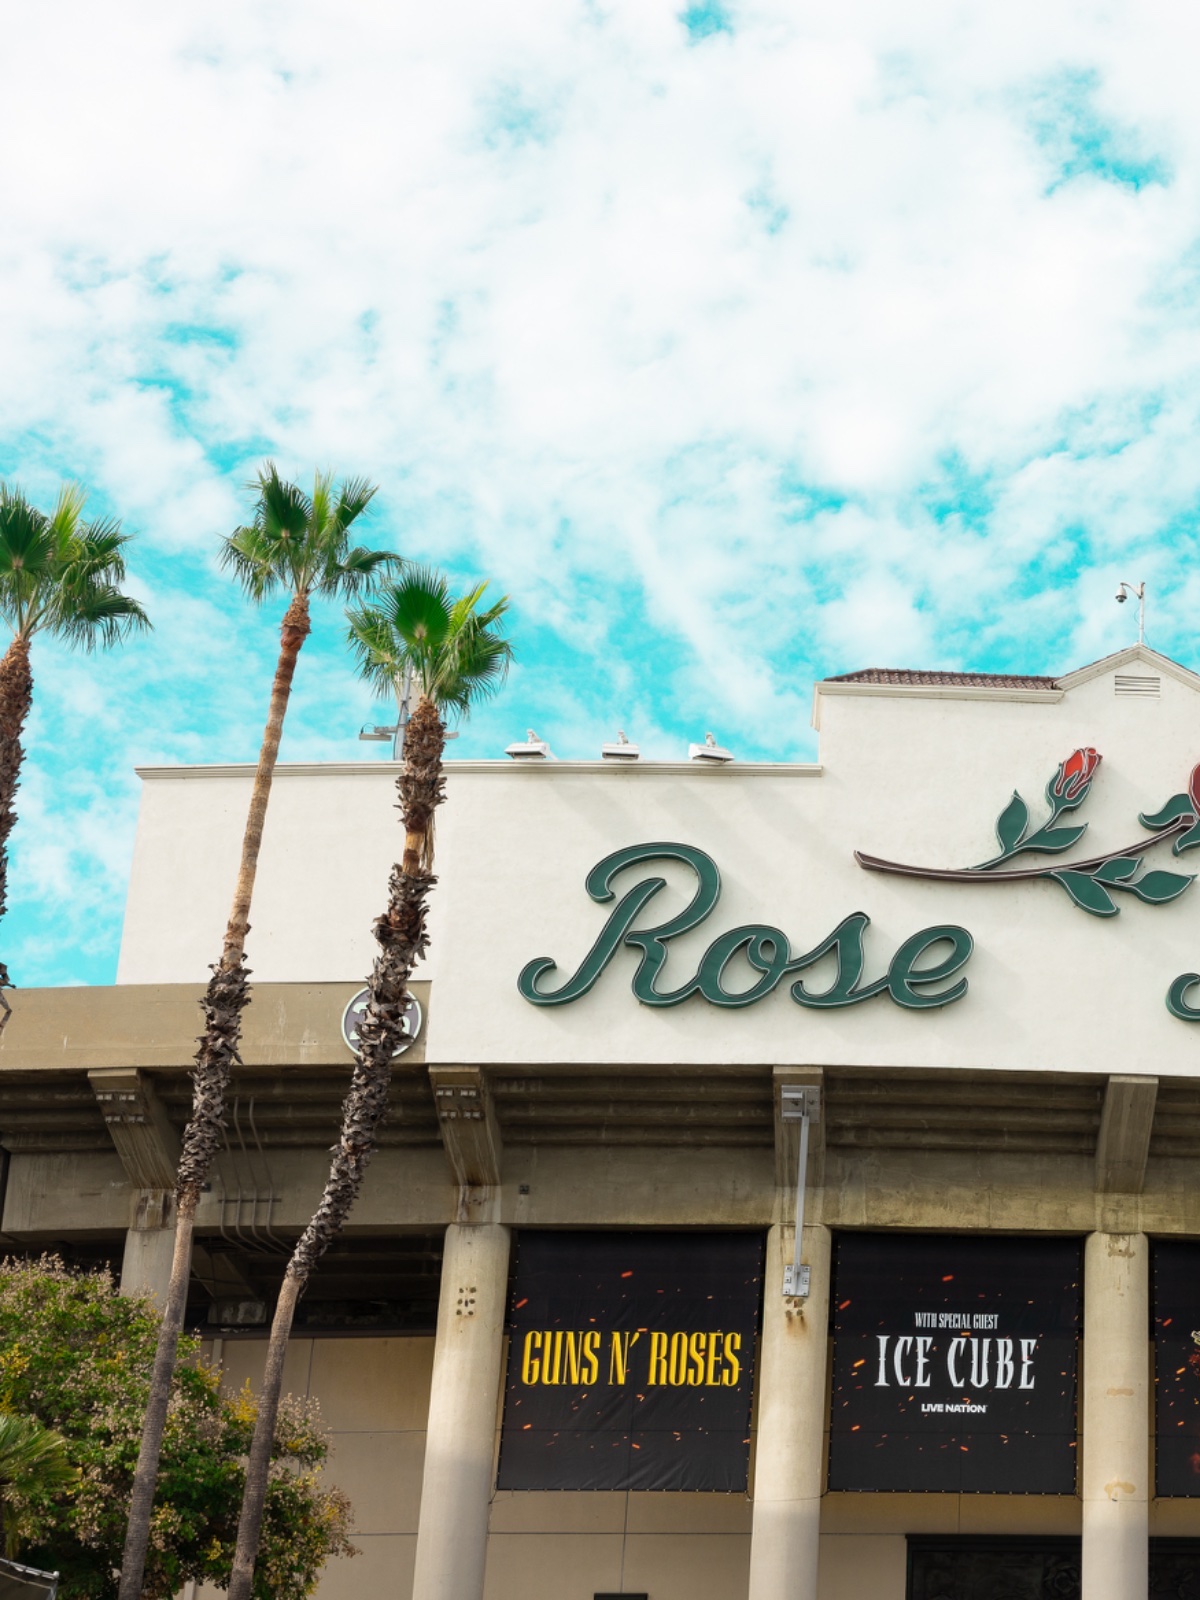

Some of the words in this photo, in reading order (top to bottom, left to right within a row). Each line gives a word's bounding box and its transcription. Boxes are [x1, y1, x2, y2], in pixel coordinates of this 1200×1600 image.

[517, 841, 975, 1010] Rose
[914, 1312, 937, 1328] WITH
[938, 1313, 972, 1329] SPECIAL
[973, 1314, 999, 1330] GUEST
[521, 1330, 602, 1386] GUNS
[646, 1331, 742, 1387] ROSES
[874, 1335, 933, 1387] ICE
[947, 1337, 1037, 1390] CUBE
[921, 1403, 944, 1413] LIVE
[945, 1404, 987, 1413] NATION
